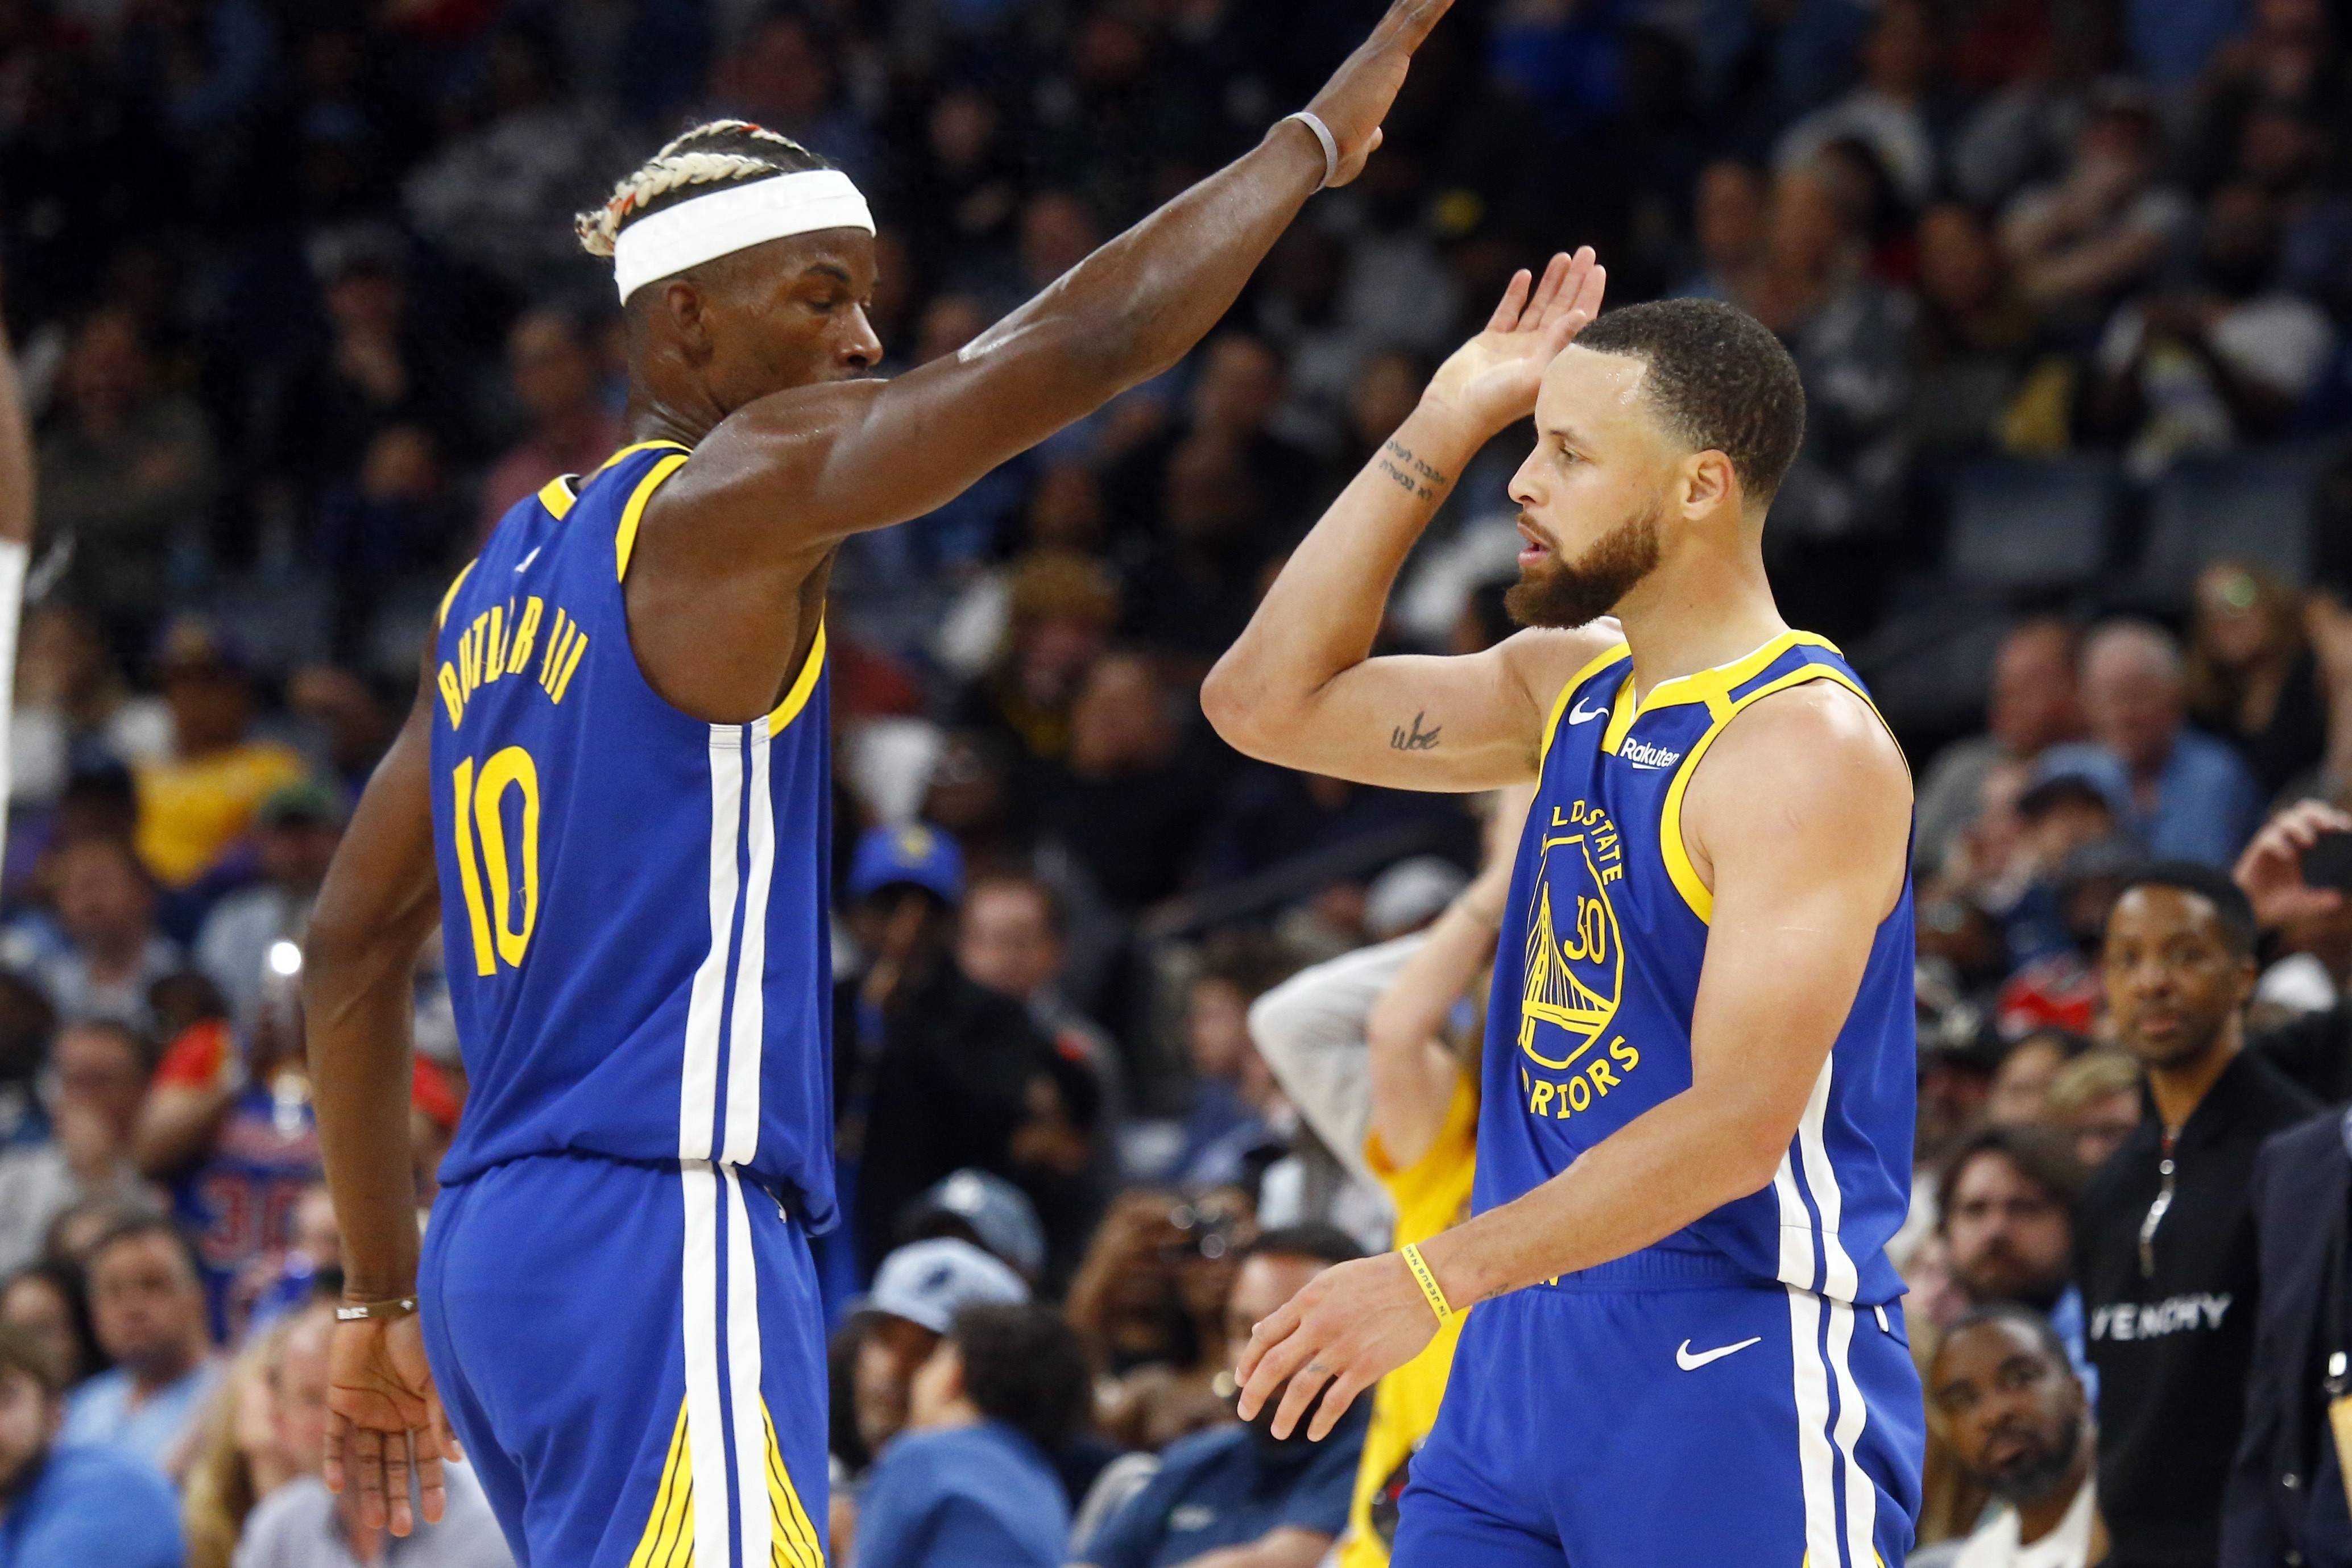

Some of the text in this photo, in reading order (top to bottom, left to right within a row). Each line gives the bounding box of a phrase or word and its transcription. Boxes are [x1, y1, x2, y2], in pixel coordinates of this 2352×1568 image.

[437, 595, 589, 732] BUTLR III
[1619, 736, 1680, 768] Rakuten
[453, 746, 540, 976] 10
[1545, 799, 1624, 886] LD STATE
[1563, 895, 1605, 965] 30
[1522, 1035, 1640, 1119] RIORS
[1418, 1268, 1440, 1301] JESUS
[1438, 1305, 1447, 1317] IN
